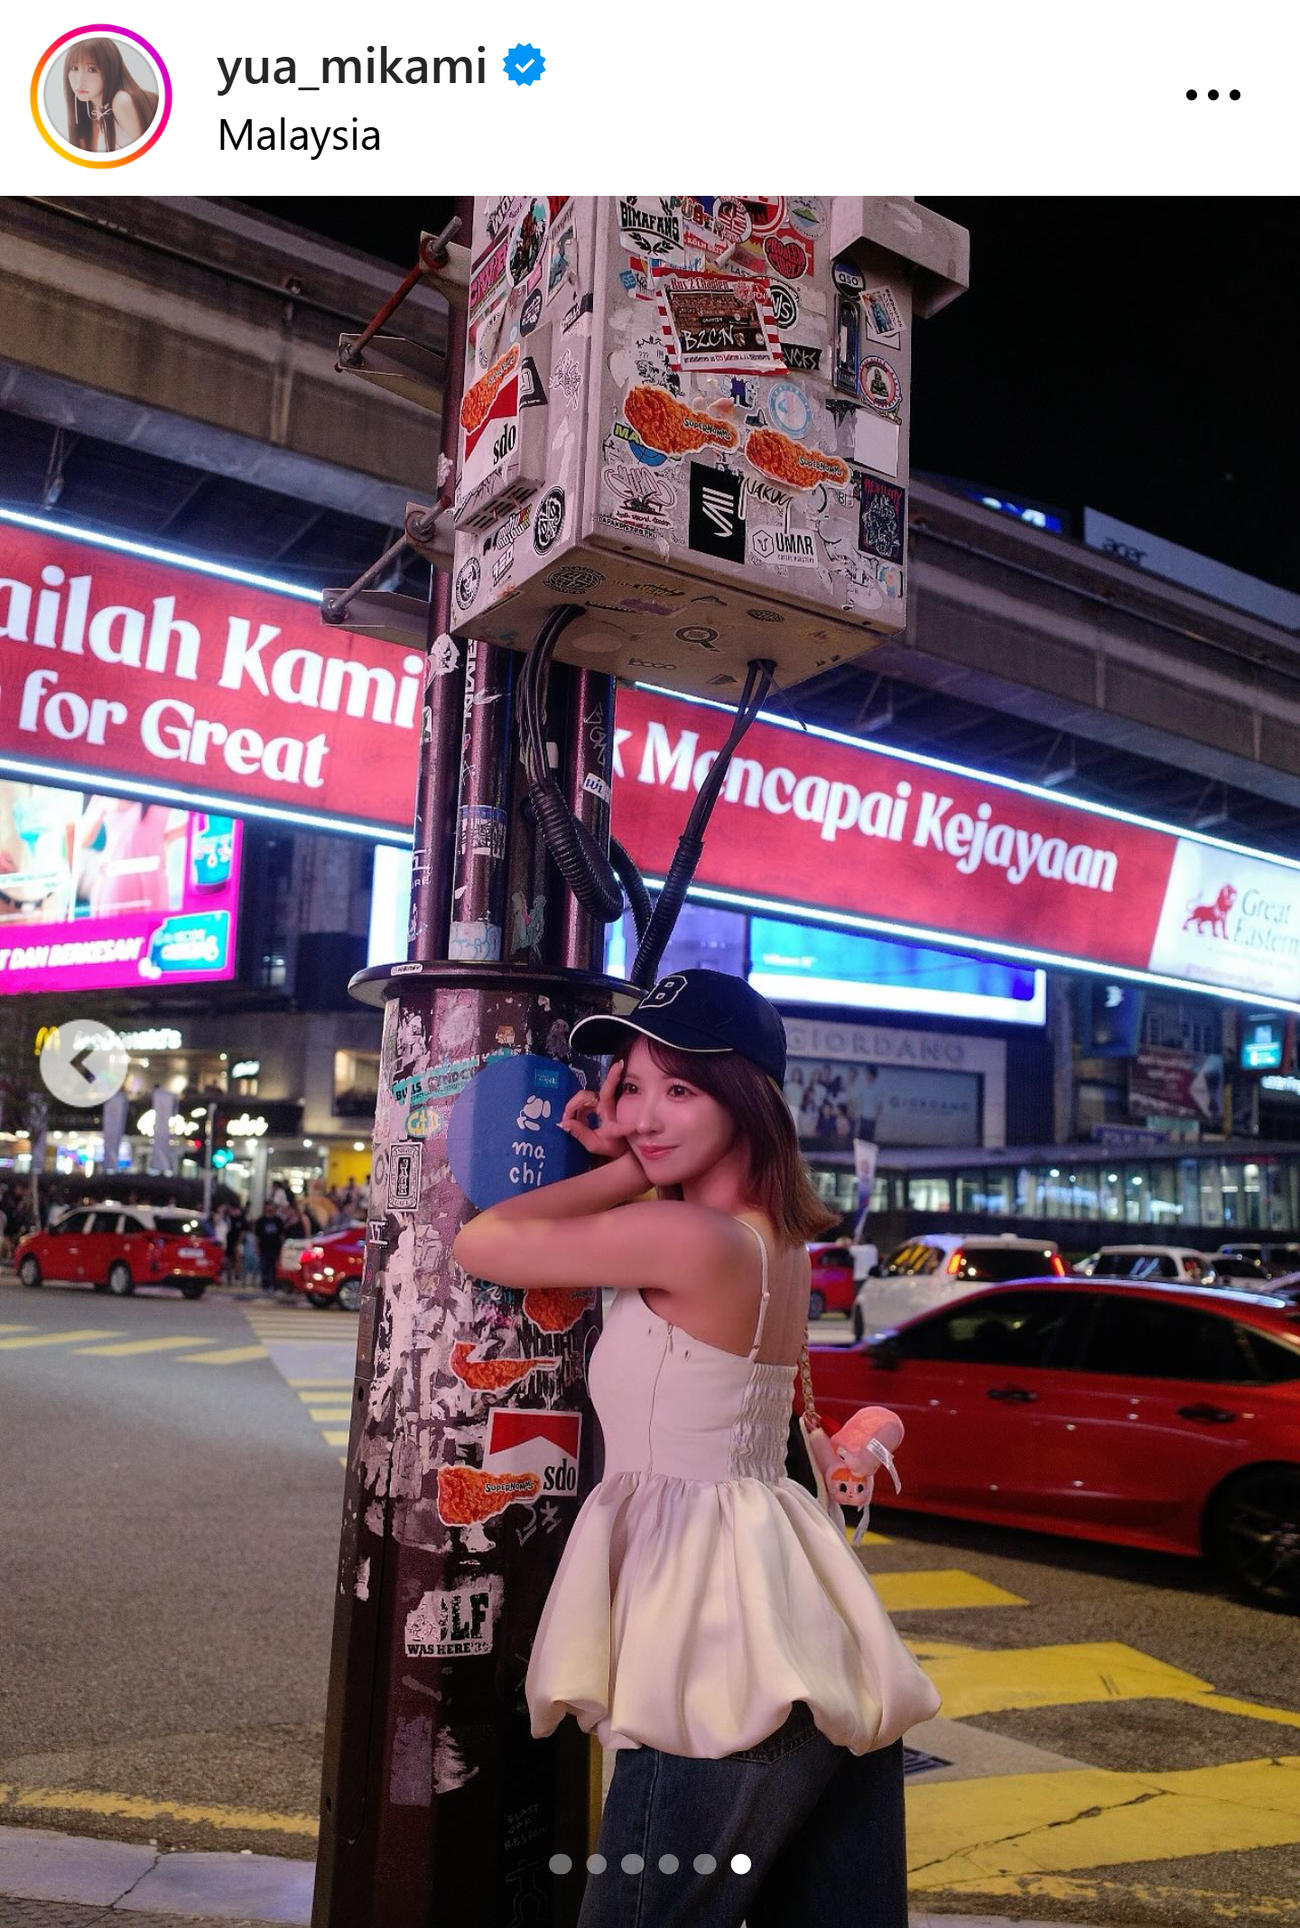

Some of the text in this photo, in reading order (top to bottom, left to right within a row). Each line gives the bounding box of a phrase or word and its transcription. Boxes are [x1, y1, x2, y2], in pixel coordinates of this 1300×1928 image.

[620, 200, 680, 243] BIMAFANS
[492, 423, 516, 464] sdo
[775, 532, 814, 556] UMAR
[217, 615, 424, 729] Kami
[18, 669, 330, 788] for Great
[912, 791, 1118, 893] Kejayaan
[1241, 888, 1292, 925] Great
[1233, 916, 1299, 956] Eastern
[638, 975, 688, 1009] B
[789, 1025, 966, 1064] GIORDANO
[509, 1162, 544, 1187] chi
[543, 1458, 576, 1491] sdo
[407, 1643, 434, 1655] WAS
[437, 1642, 471, 1655] HERE
